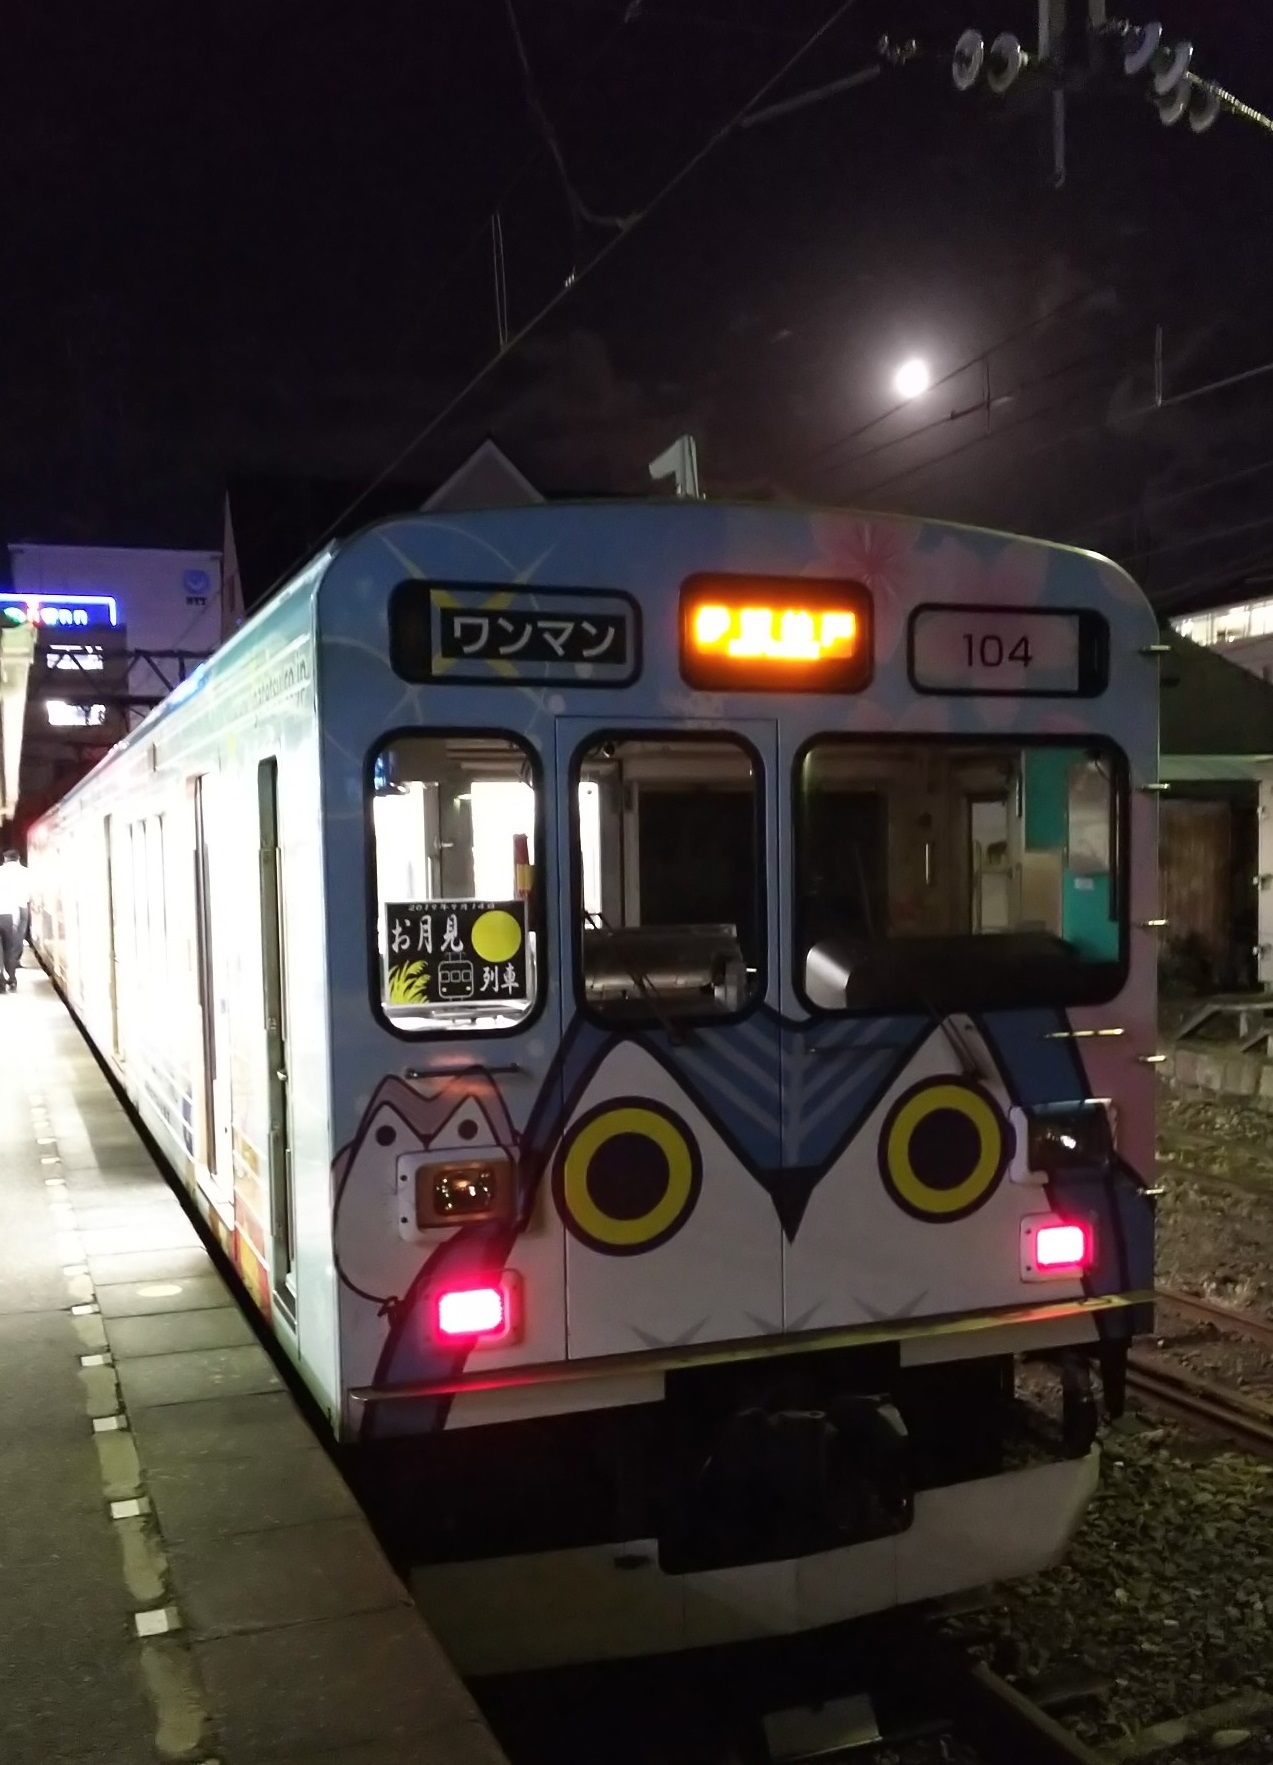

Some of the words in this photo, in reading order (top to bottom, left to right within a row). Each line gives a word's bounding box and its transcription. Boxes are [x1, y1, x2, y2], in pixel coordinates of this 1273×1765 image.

[453, 616, 615, 657] ワンマン
[963, 634, 1032, 667] 104
[391, 914, 464, 954] お月見
[480, 962, 519, 995] 列車
